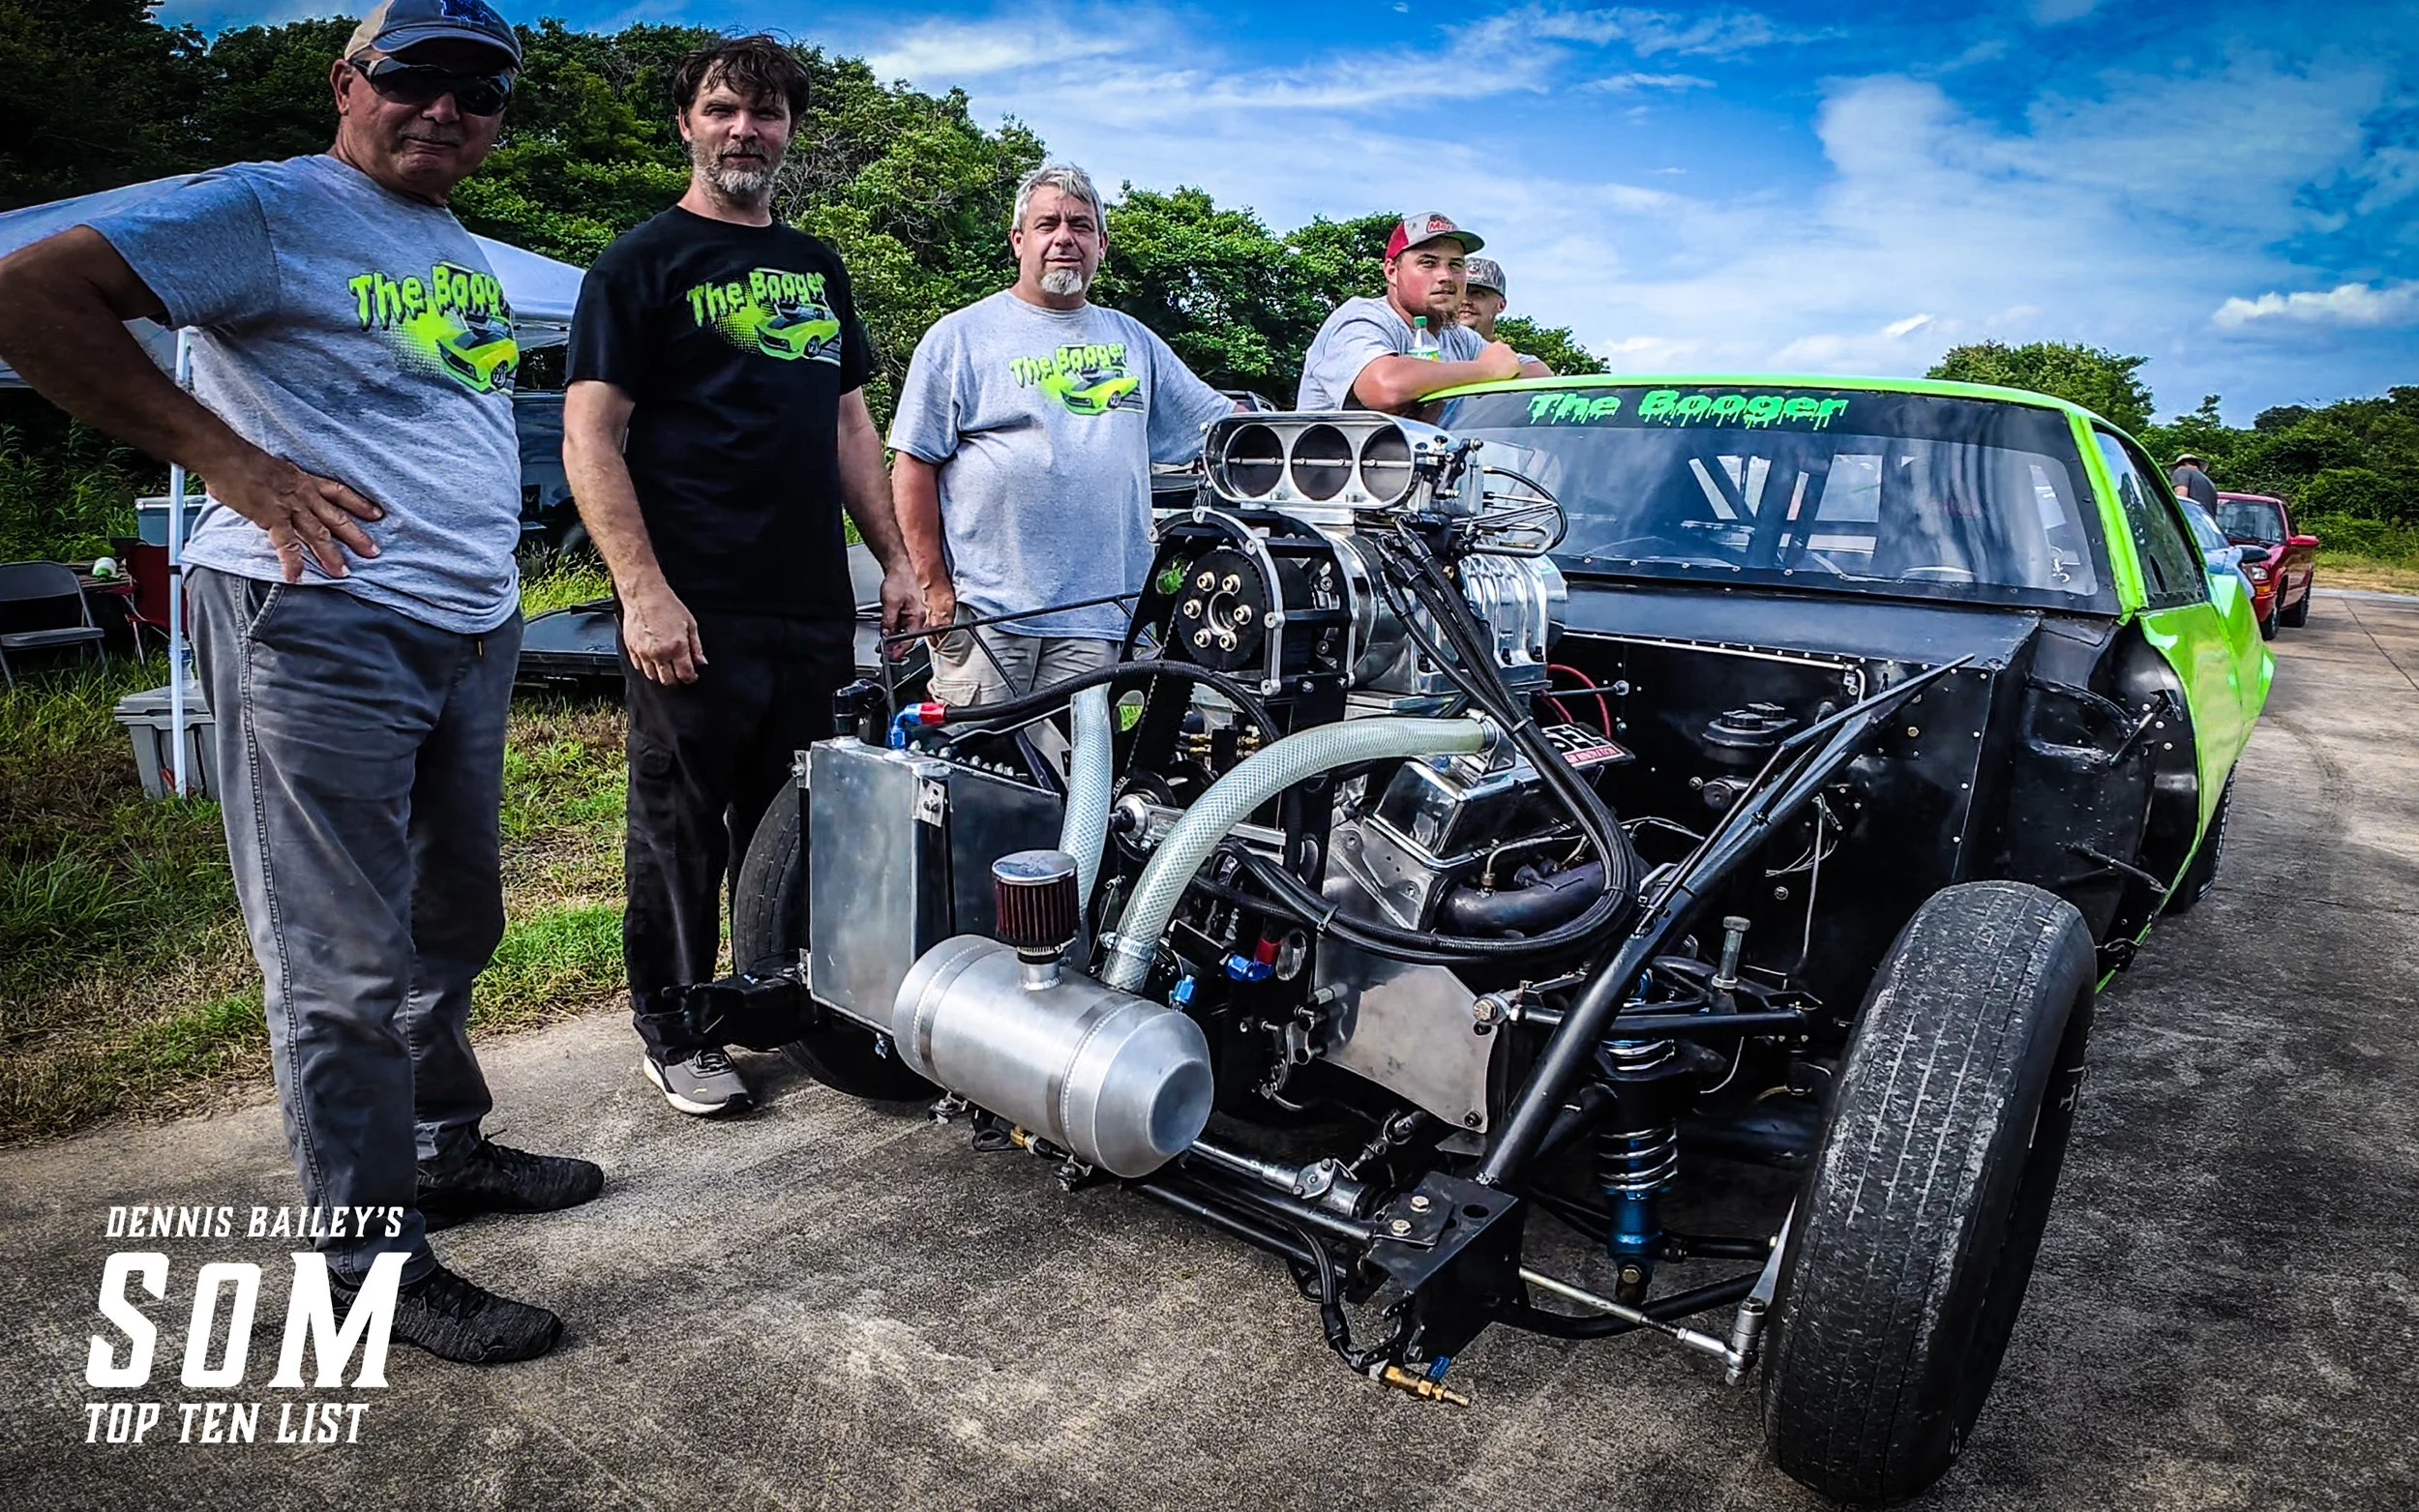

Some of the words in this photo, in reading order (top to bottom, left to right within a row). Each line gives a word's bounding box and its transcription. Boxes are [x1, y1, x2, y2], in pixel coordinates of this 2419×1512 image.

[348, 270, 428, 331] The
[431, 263, 503, 317] Boog
[686, 282, 746, 327] The
[748, 271, 825, 307] Booger
[1008, 354, 1055, 388] The
[1055, 342, 1126, 376] Booger
[1527, 393, 1622, 425] The
[1638, 390, 1849, 430] Booger
